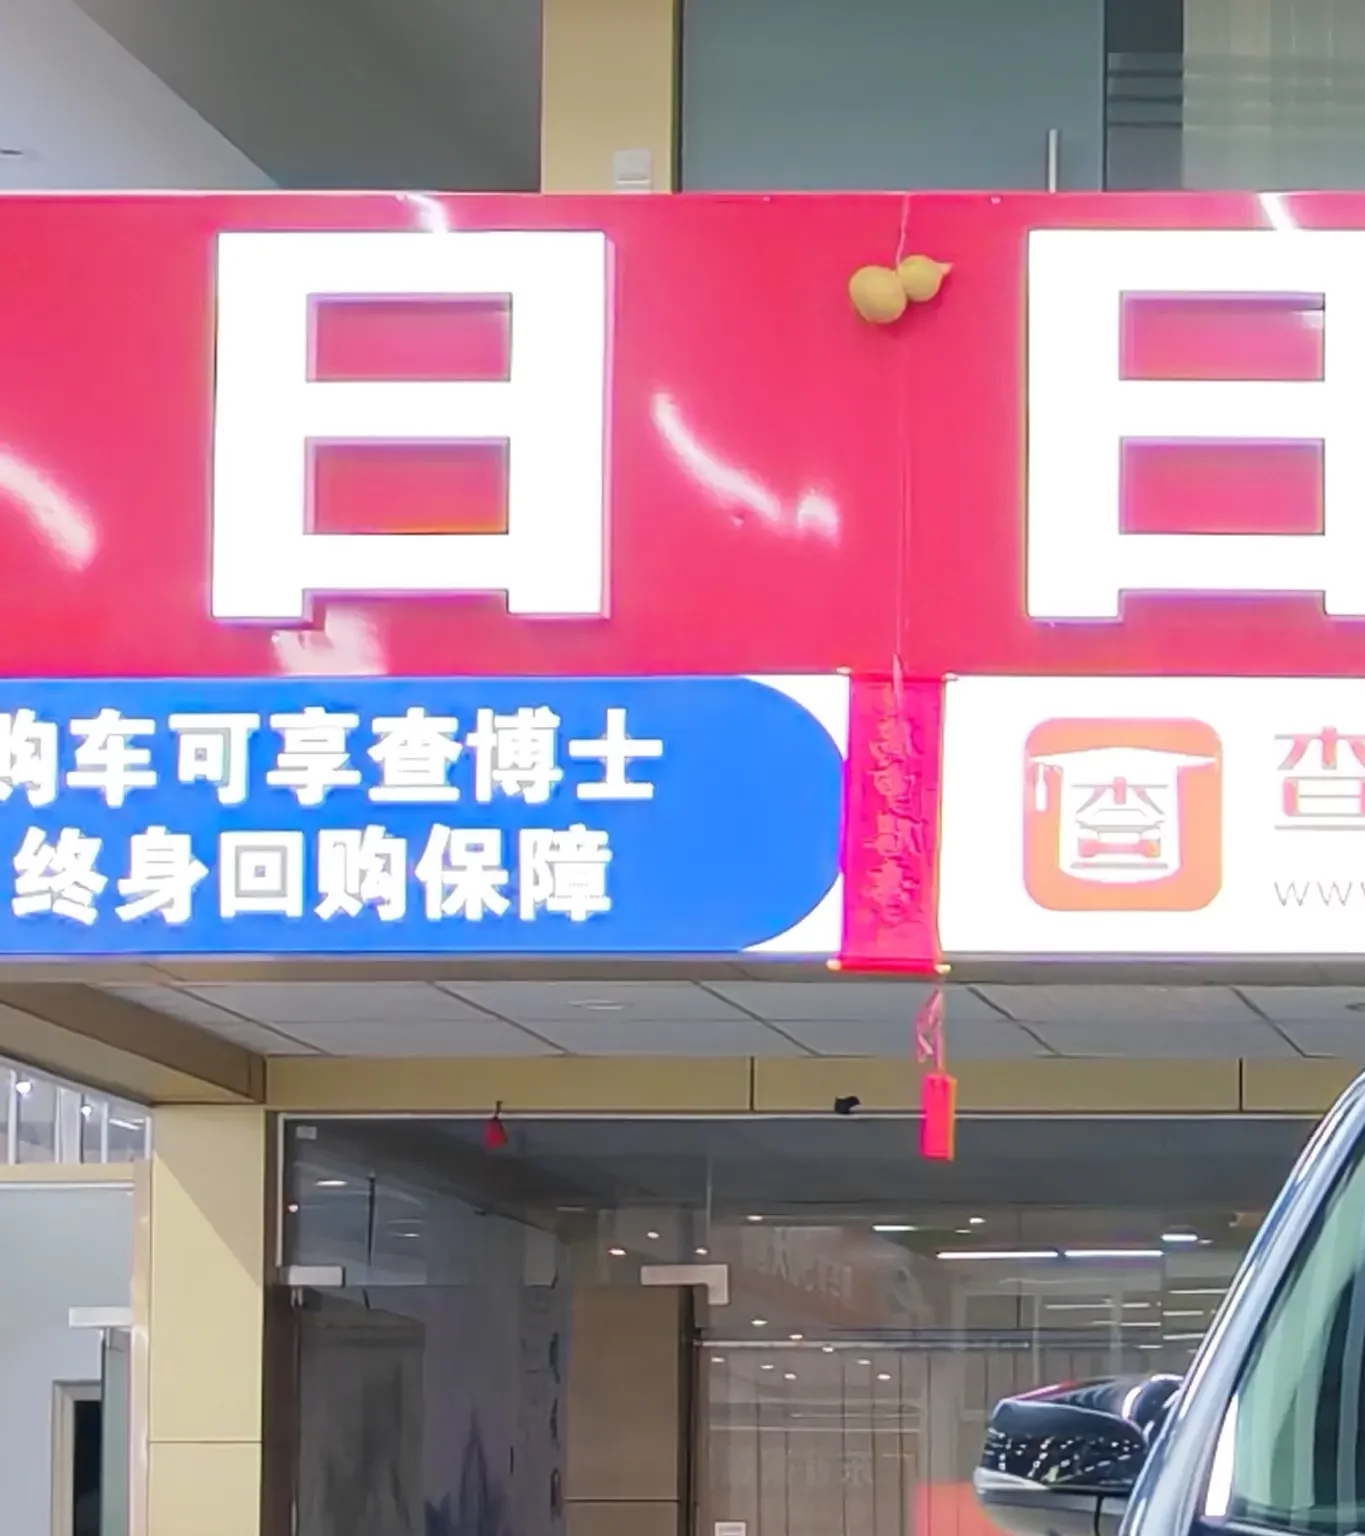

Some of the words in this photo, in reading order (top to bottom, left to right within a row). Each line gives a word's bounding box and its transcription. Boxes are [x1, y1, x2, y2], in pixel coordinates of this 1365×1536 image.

[0, 706, 665, 808] 购车可享查博士
[11, 823, 614, 926] 终身回购保障
